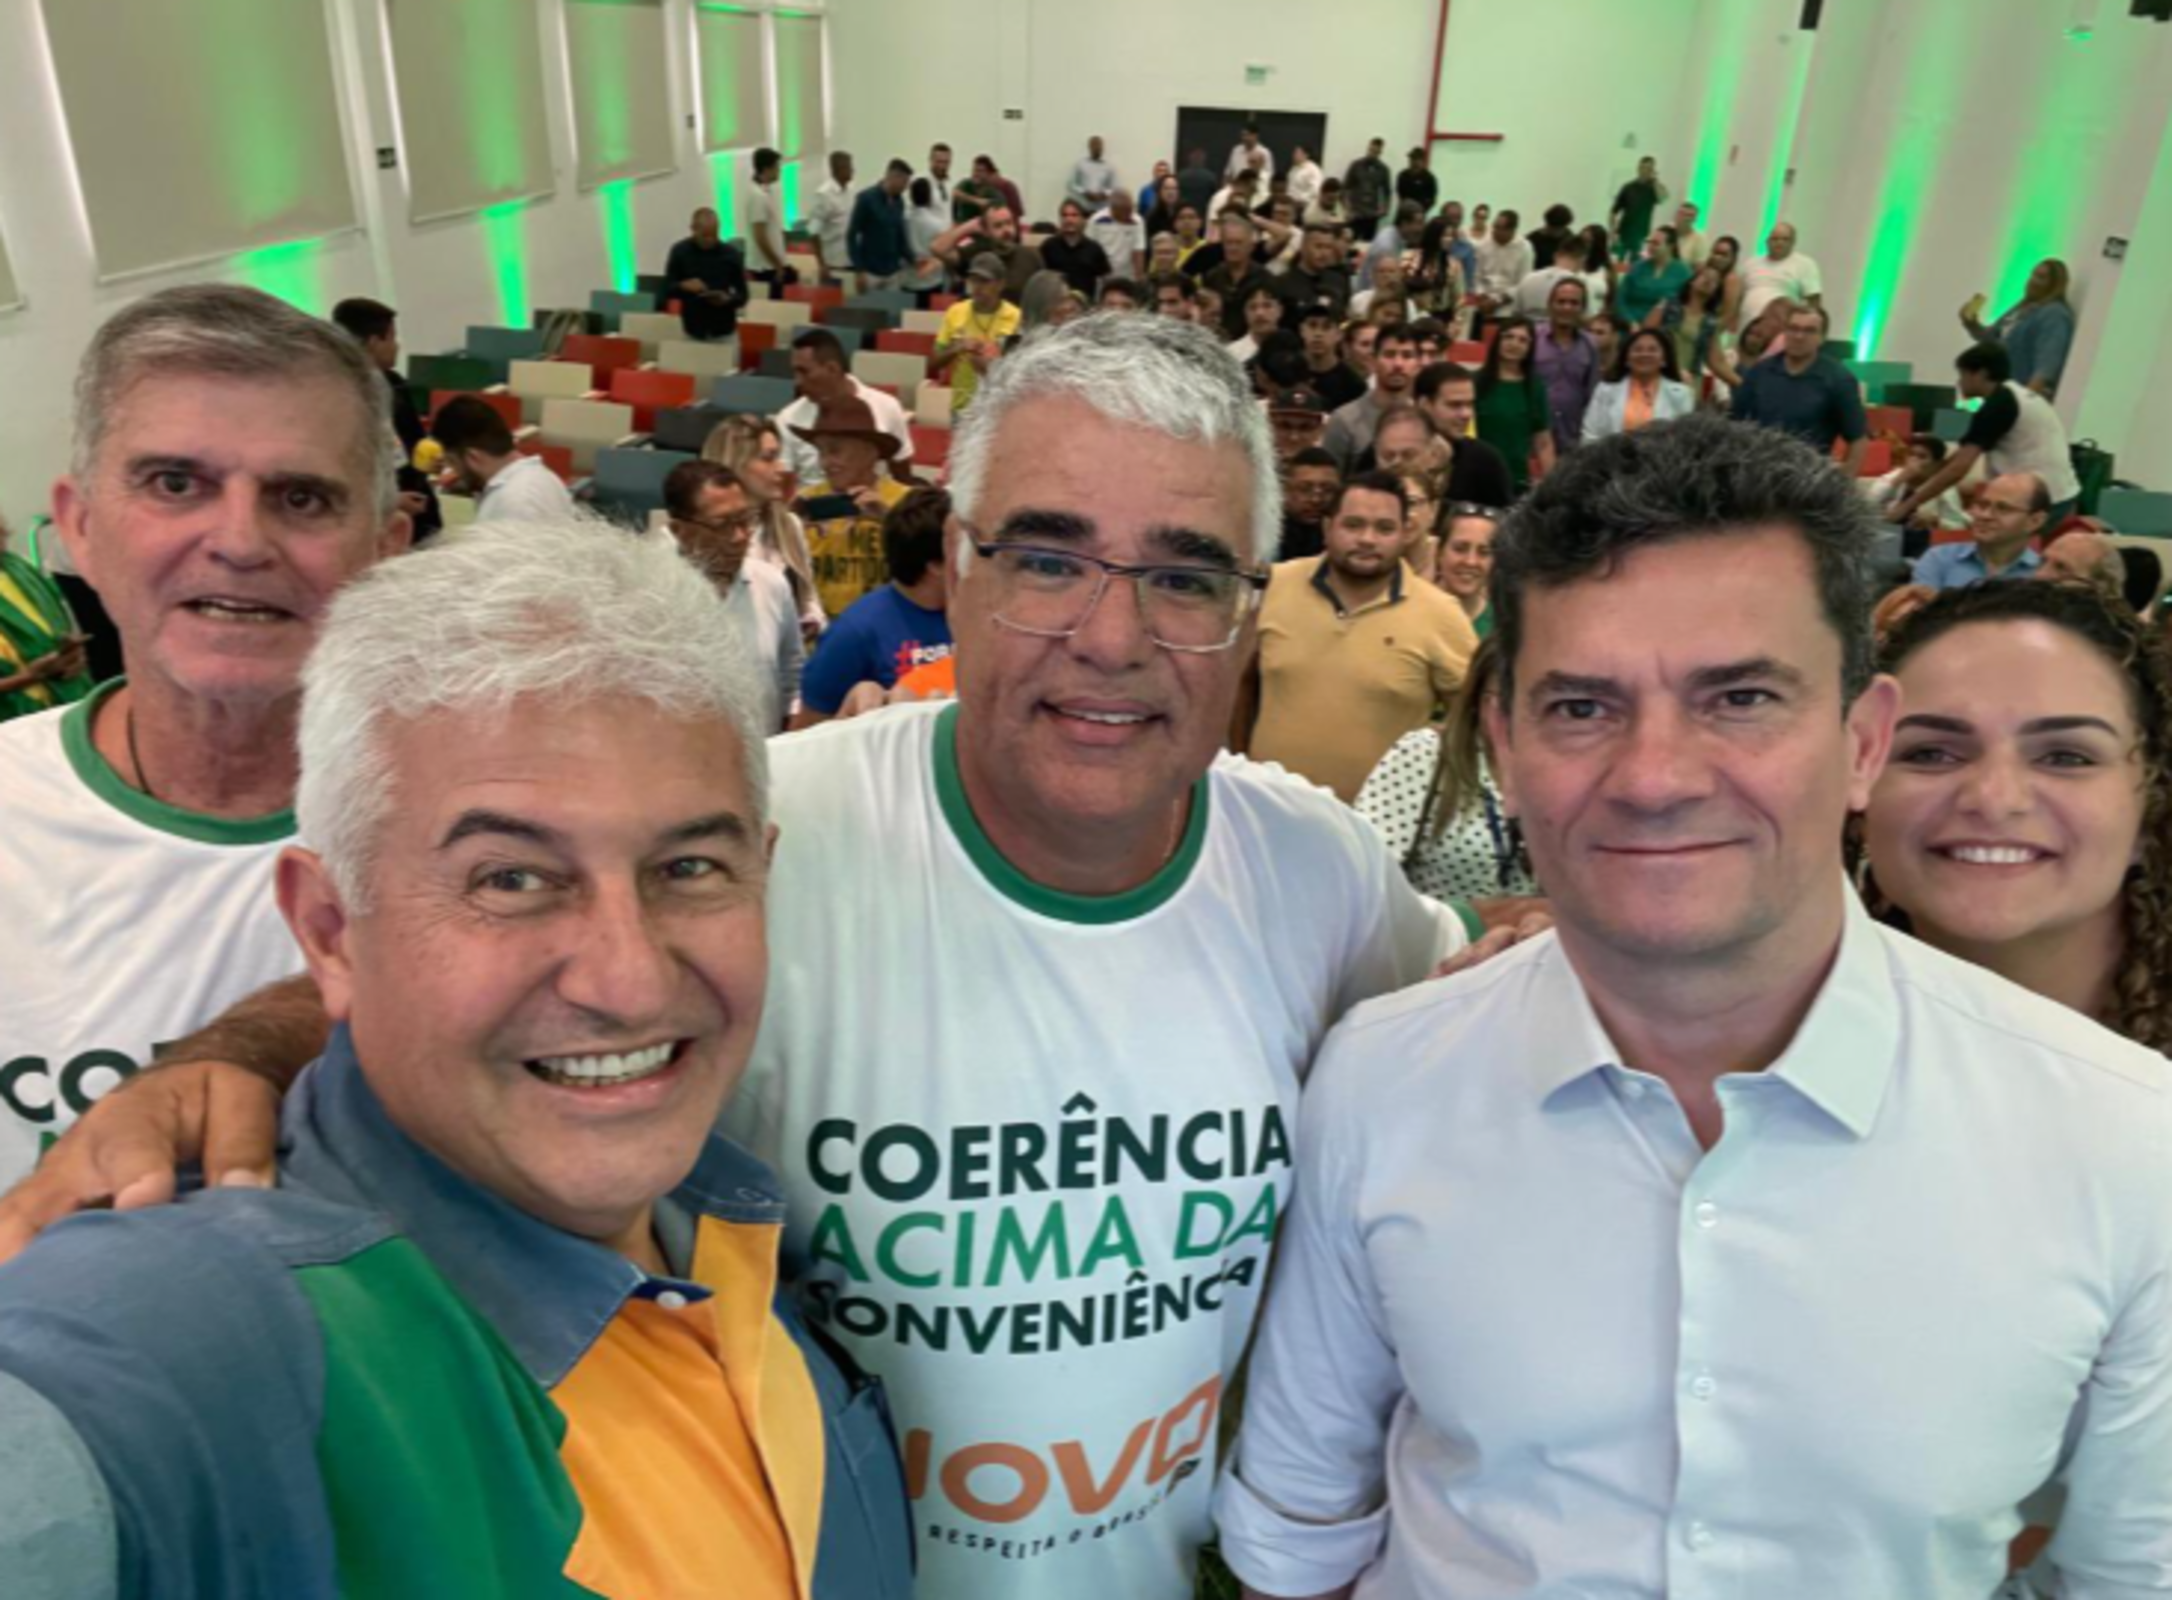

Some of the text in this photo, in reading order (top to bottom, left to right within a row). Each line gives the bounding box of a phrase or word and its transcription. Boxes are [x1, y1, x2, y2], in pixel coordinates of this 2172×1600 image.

[849, 526, 884, 554] ME
[0, 1043, 174, 1122] CO
[807, 1091, 1293, 1202] COERÊNCIA
[808, 1182, 1276, 1289] ACIMA DA
[805, 1256, 1257, 1355] CONVENIÊNCA
[928, 1524, 1056, 1559] RESPEITA
